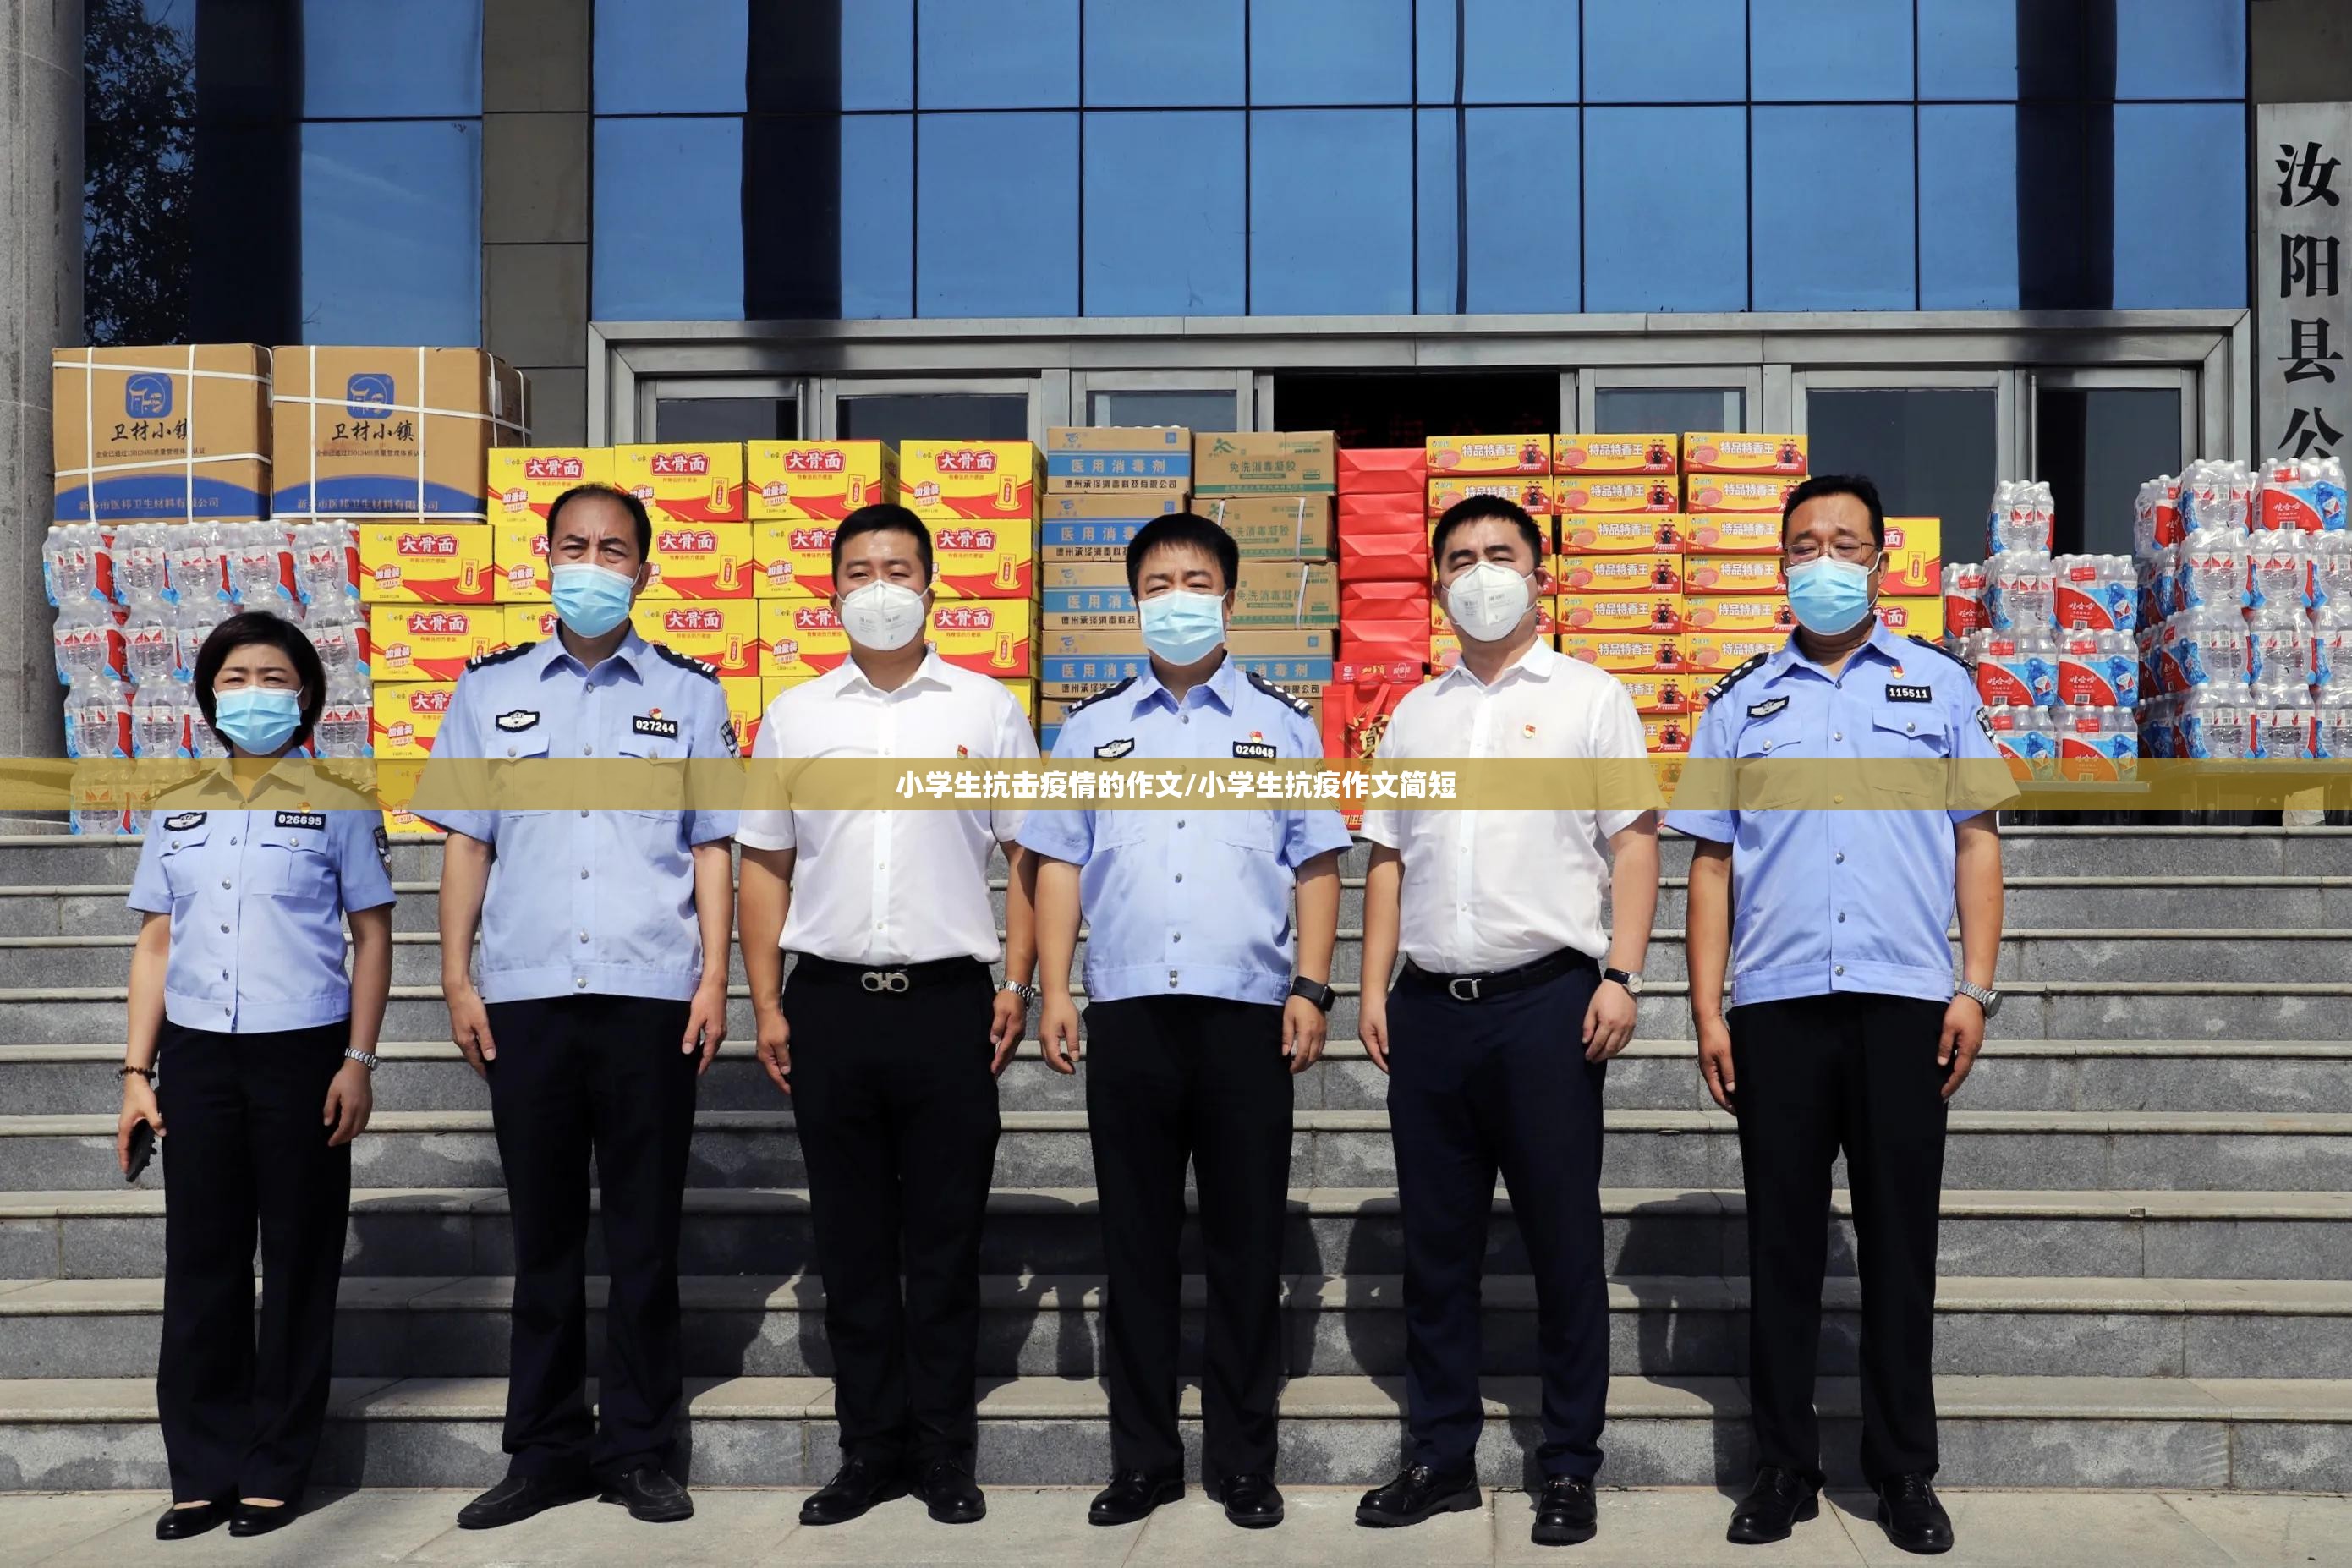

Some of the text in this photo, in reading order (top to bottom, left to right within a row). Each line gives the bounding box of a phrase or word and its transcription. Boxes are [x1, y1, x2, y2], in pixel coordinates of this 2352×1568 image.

[2274, 140, 2344, 460] 汝阳县公
[331, 419, 414, 442] 卫材小镇
[1461, 444, 1516, 457] 特品特香王
[1588, 442, 1643, 456] 特品特香王
[1719, 441, 1774, 454] 特品特香王
[653, 455, 708, 474] 大骨面
[787, 450, 842, 470] 大骨面
[940, 450, 994, 470] 大骨面
[1072, 458, 1165, 474] 医用消毒剂
[1229, 460, 1296, 473] 免洗消毒凝胶
[527, 458, 582, 478] 大骨面
[1590, 484, 1645, 497] 特品特香王
[1724, 483, 1778, 496] 特品特香王
[1598, 523, 1652, 535] 特品特香王
[1721, 522, 1775, 535] 特品特香王
[400, 535, 456, 554] 大骨面
[659, 531, 714, 551] 大骨面
[939, 529, 994, 549] 大骨面
[1594, 563, 1649, 576] 特品特香王
[1720, 562, 1775, 576] 特品特香王
[1594, 602, 1649, 615] 特品特香王
[1718, 603, 1773, 616] 特品特香王
[410, 613, 467, 633] 大骨面
[666, 610, 721, 628] 大骨面
[937, 608, 990, 628] 大骨面
[1598, 643, 1653, 655] 特品特香王
[1061, 663, 1138, 678] 医用消毒
[1889, 687, 1928, 699] 115511
[414, 693, 449, 710] 大骨
[635, 719, 675, 734] 027244
[1236, 745, 1275, 758] 024048
[277, 814, 322, 826] 026695
